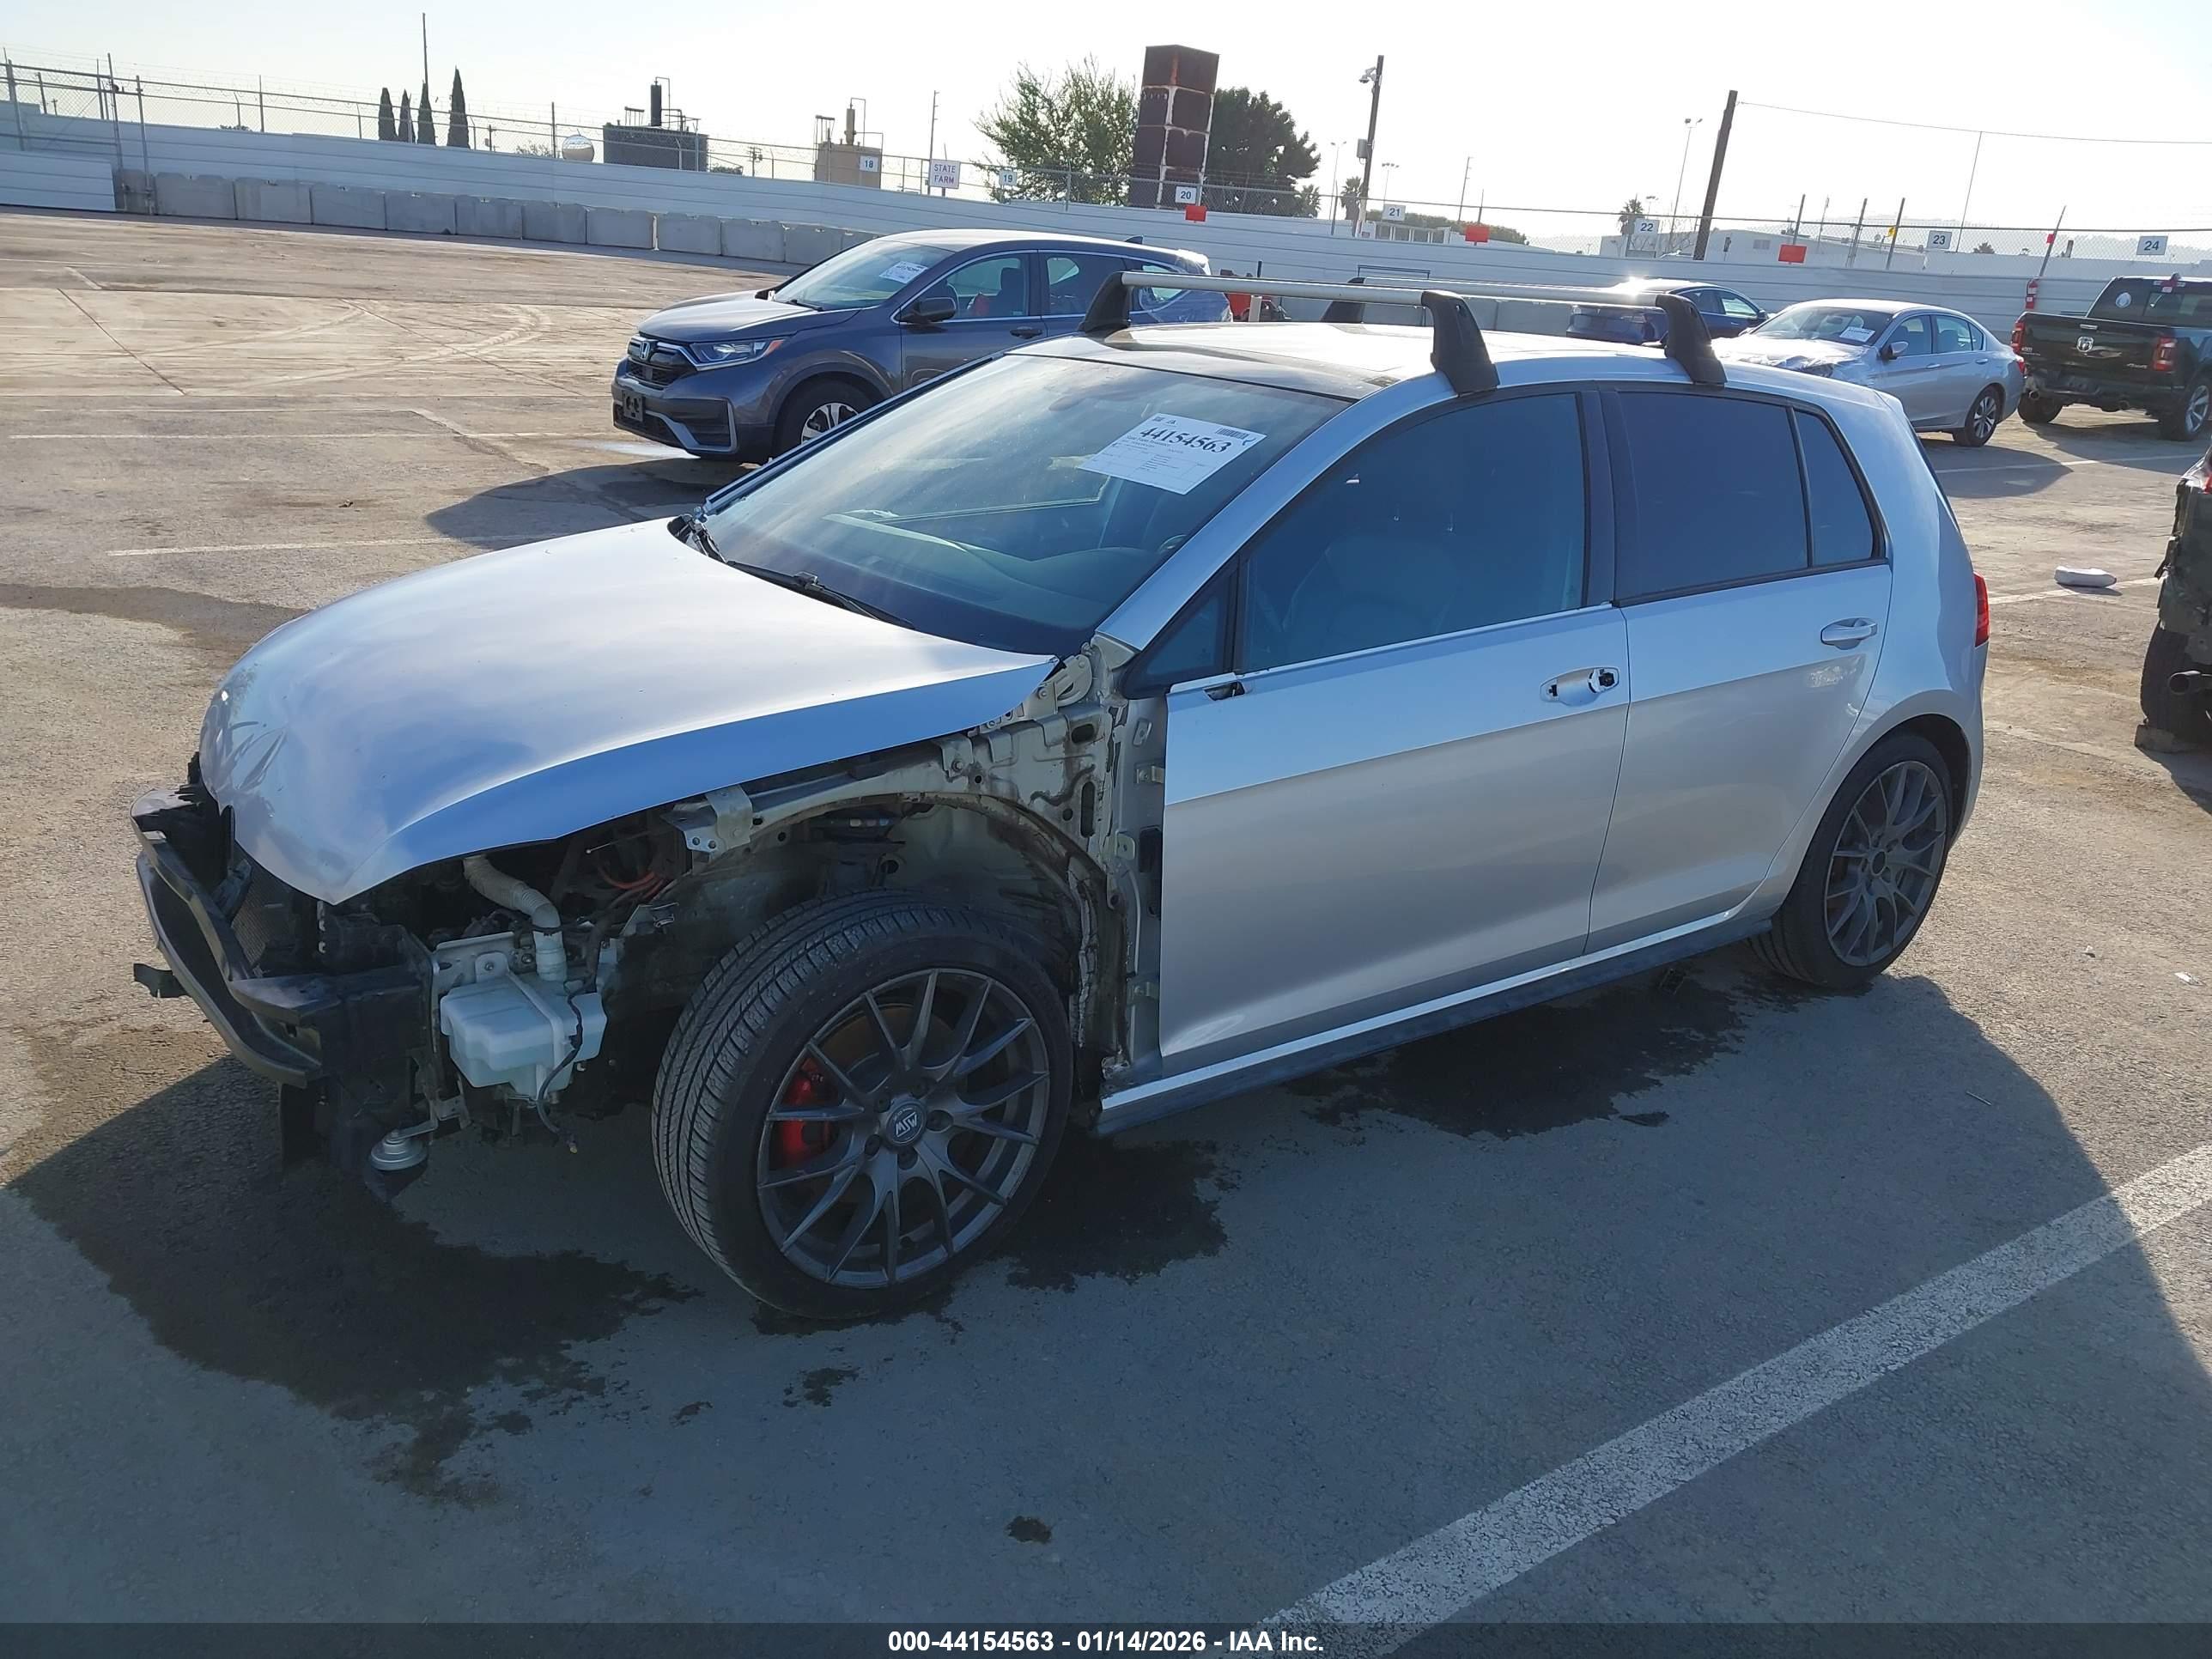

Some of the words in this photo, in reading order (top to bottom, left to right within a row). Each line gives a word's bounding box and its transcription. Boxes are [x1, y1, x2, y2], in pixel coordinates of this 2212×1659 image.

[864, 160, 873, 168] 18
[933, 163, 957, 173] STATE
[933, 175, 955, 185] FARM
[1003, 174, 1013, 183] 19
[1180, 191, 1192, 200] 20
[1389, 207, 1400, 217] 21
[1640, 222, 1654, 232] 22
[1932, 234, 1946, 245] 23
[2143, 240, 2160, 251] 24
[1139, 427, 1231, 453] 44154563
[895, 1111, 918, 1138] MSW
